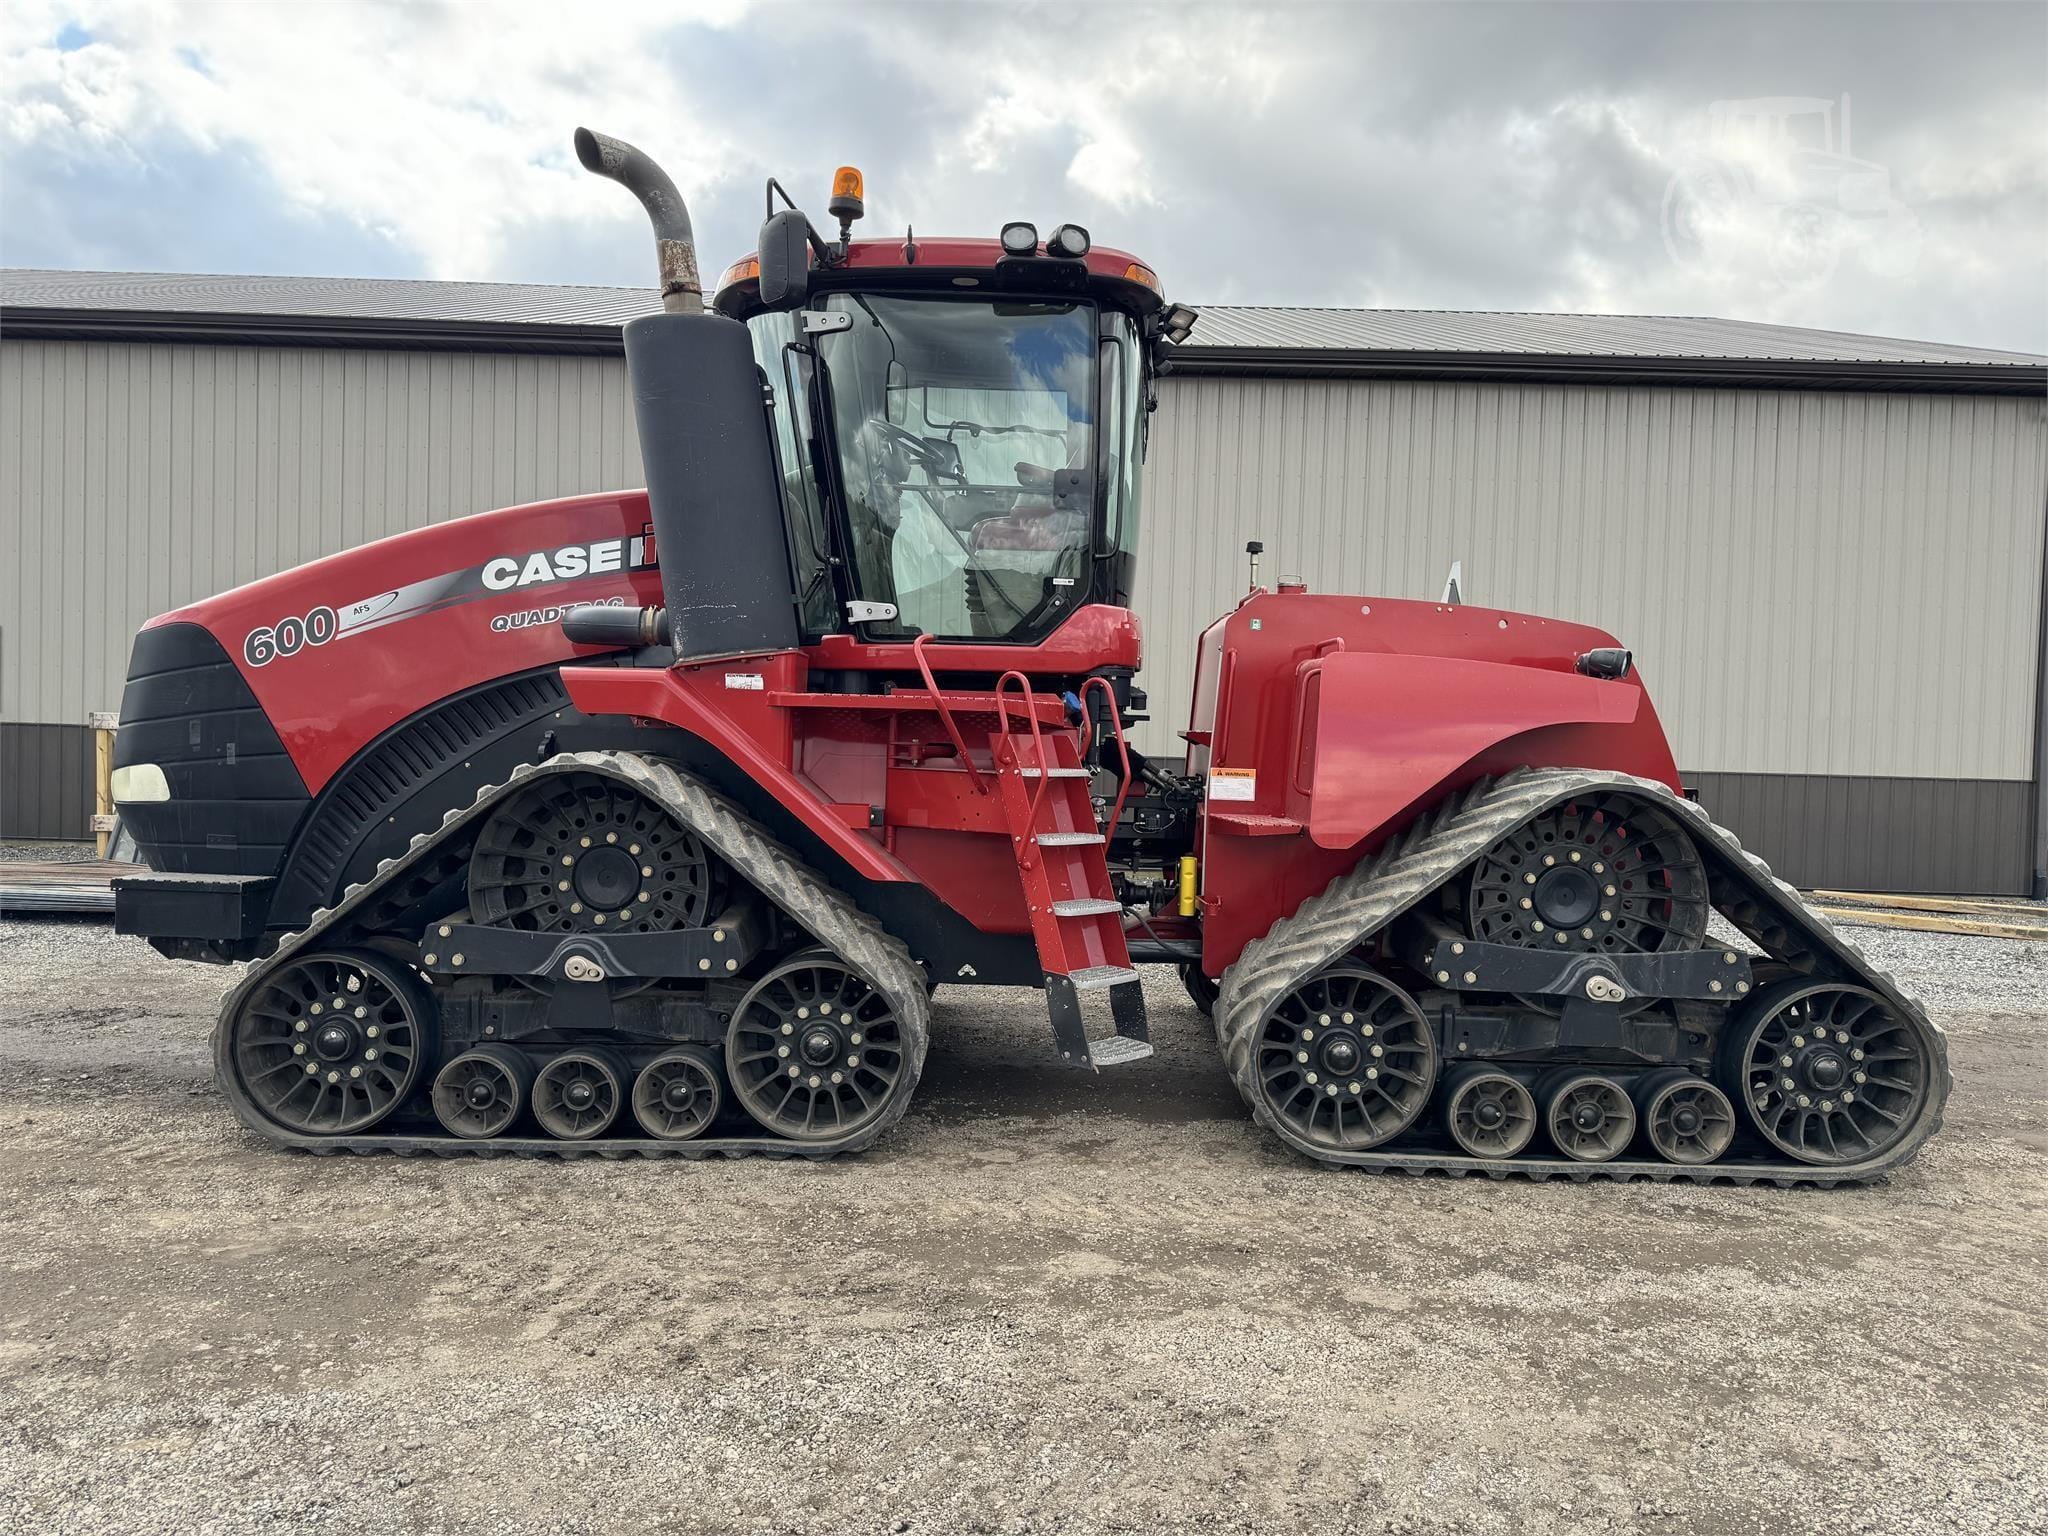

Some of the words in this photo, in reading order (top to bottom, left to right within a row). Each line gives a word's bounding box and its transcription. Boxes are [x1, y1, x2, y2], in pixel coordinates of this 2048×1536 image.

[481, 540, 622, 590] CASE
[353, 604, 370, 616] AFS
[490, 597, 624, 632] QUAD
[243, 605, 336, 668] 600
